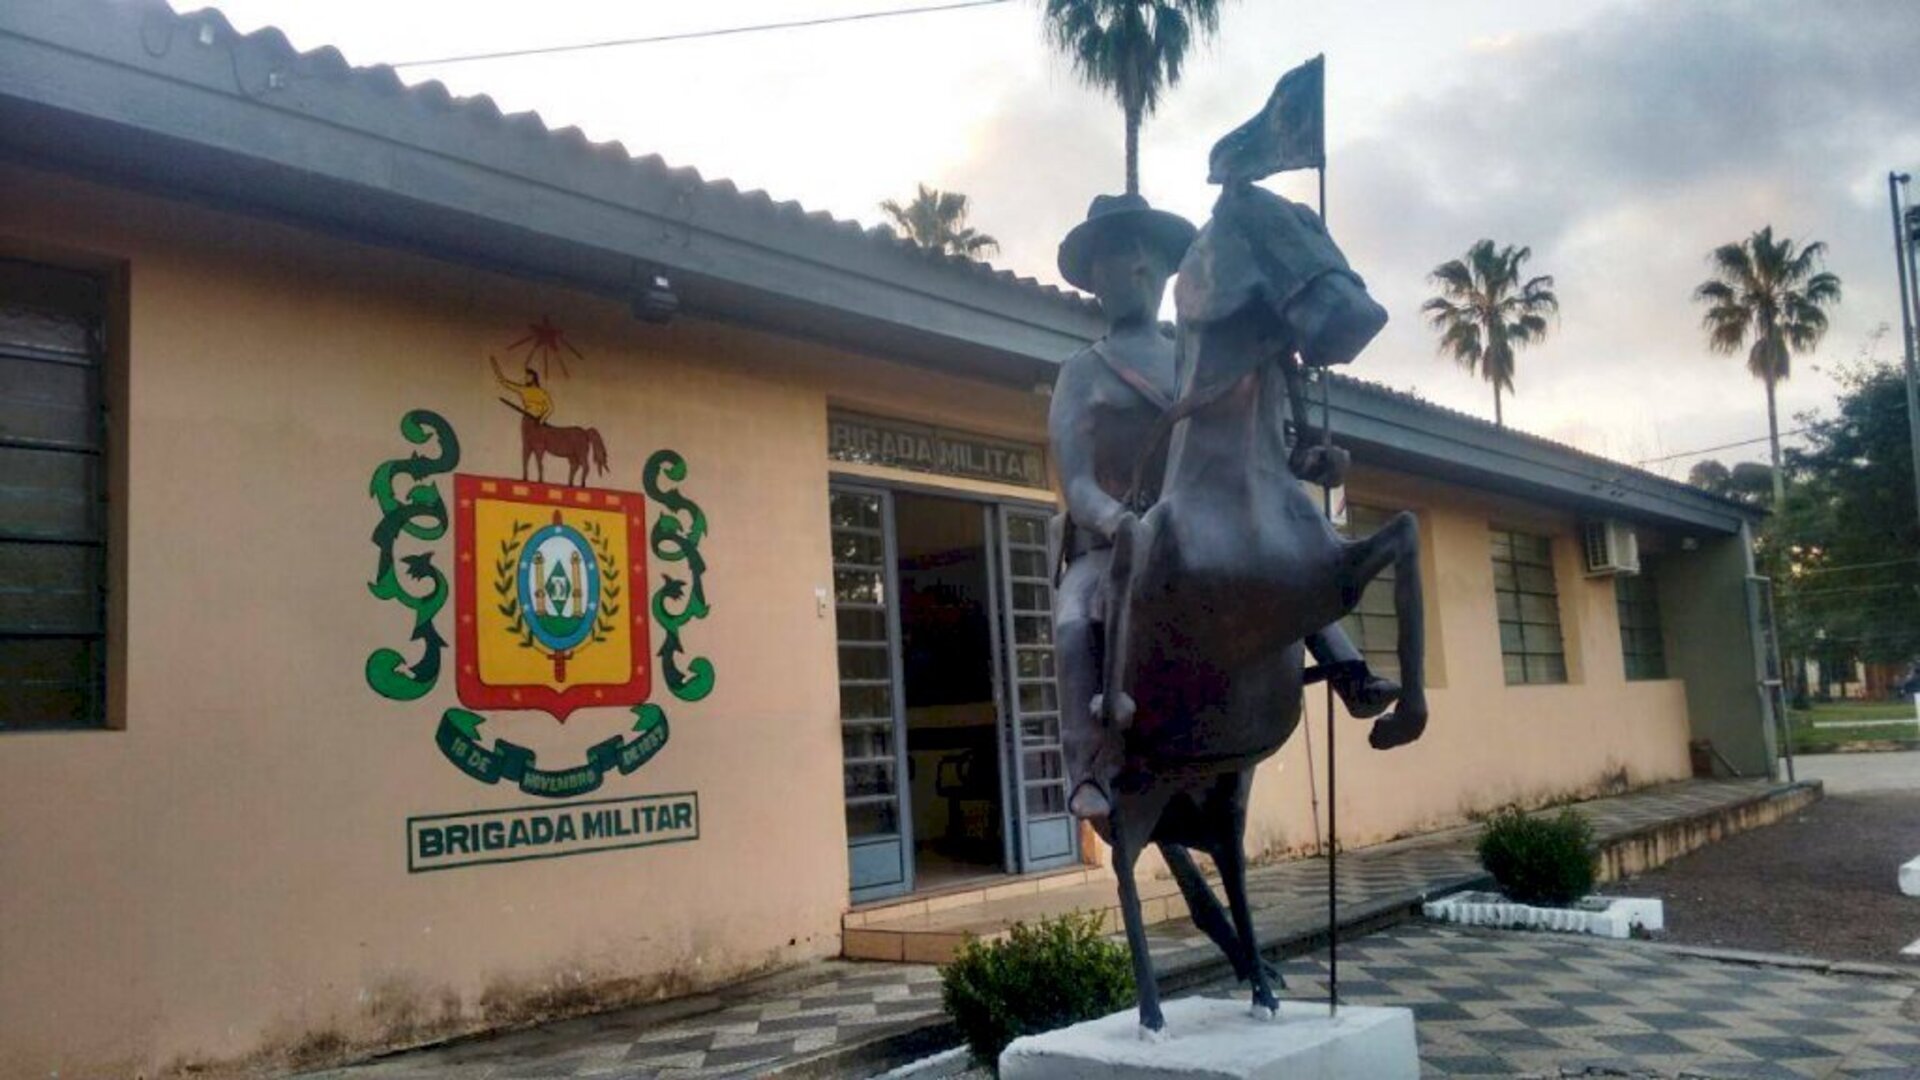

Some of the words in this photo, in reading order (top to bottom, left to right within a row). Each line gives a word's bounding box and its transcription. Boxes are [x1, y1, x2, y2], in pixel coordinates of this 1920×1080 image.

[830, 424, 933, 463] RIGADA
[938, 440, 1040, 481] MILITAR
[468, 750, 493, 774] DE
[523, 770, 596, 793] NOVEMBRO
[419, 815, 577, 858] BRIGADA
[582, 802, 692, 840] MILITAR
